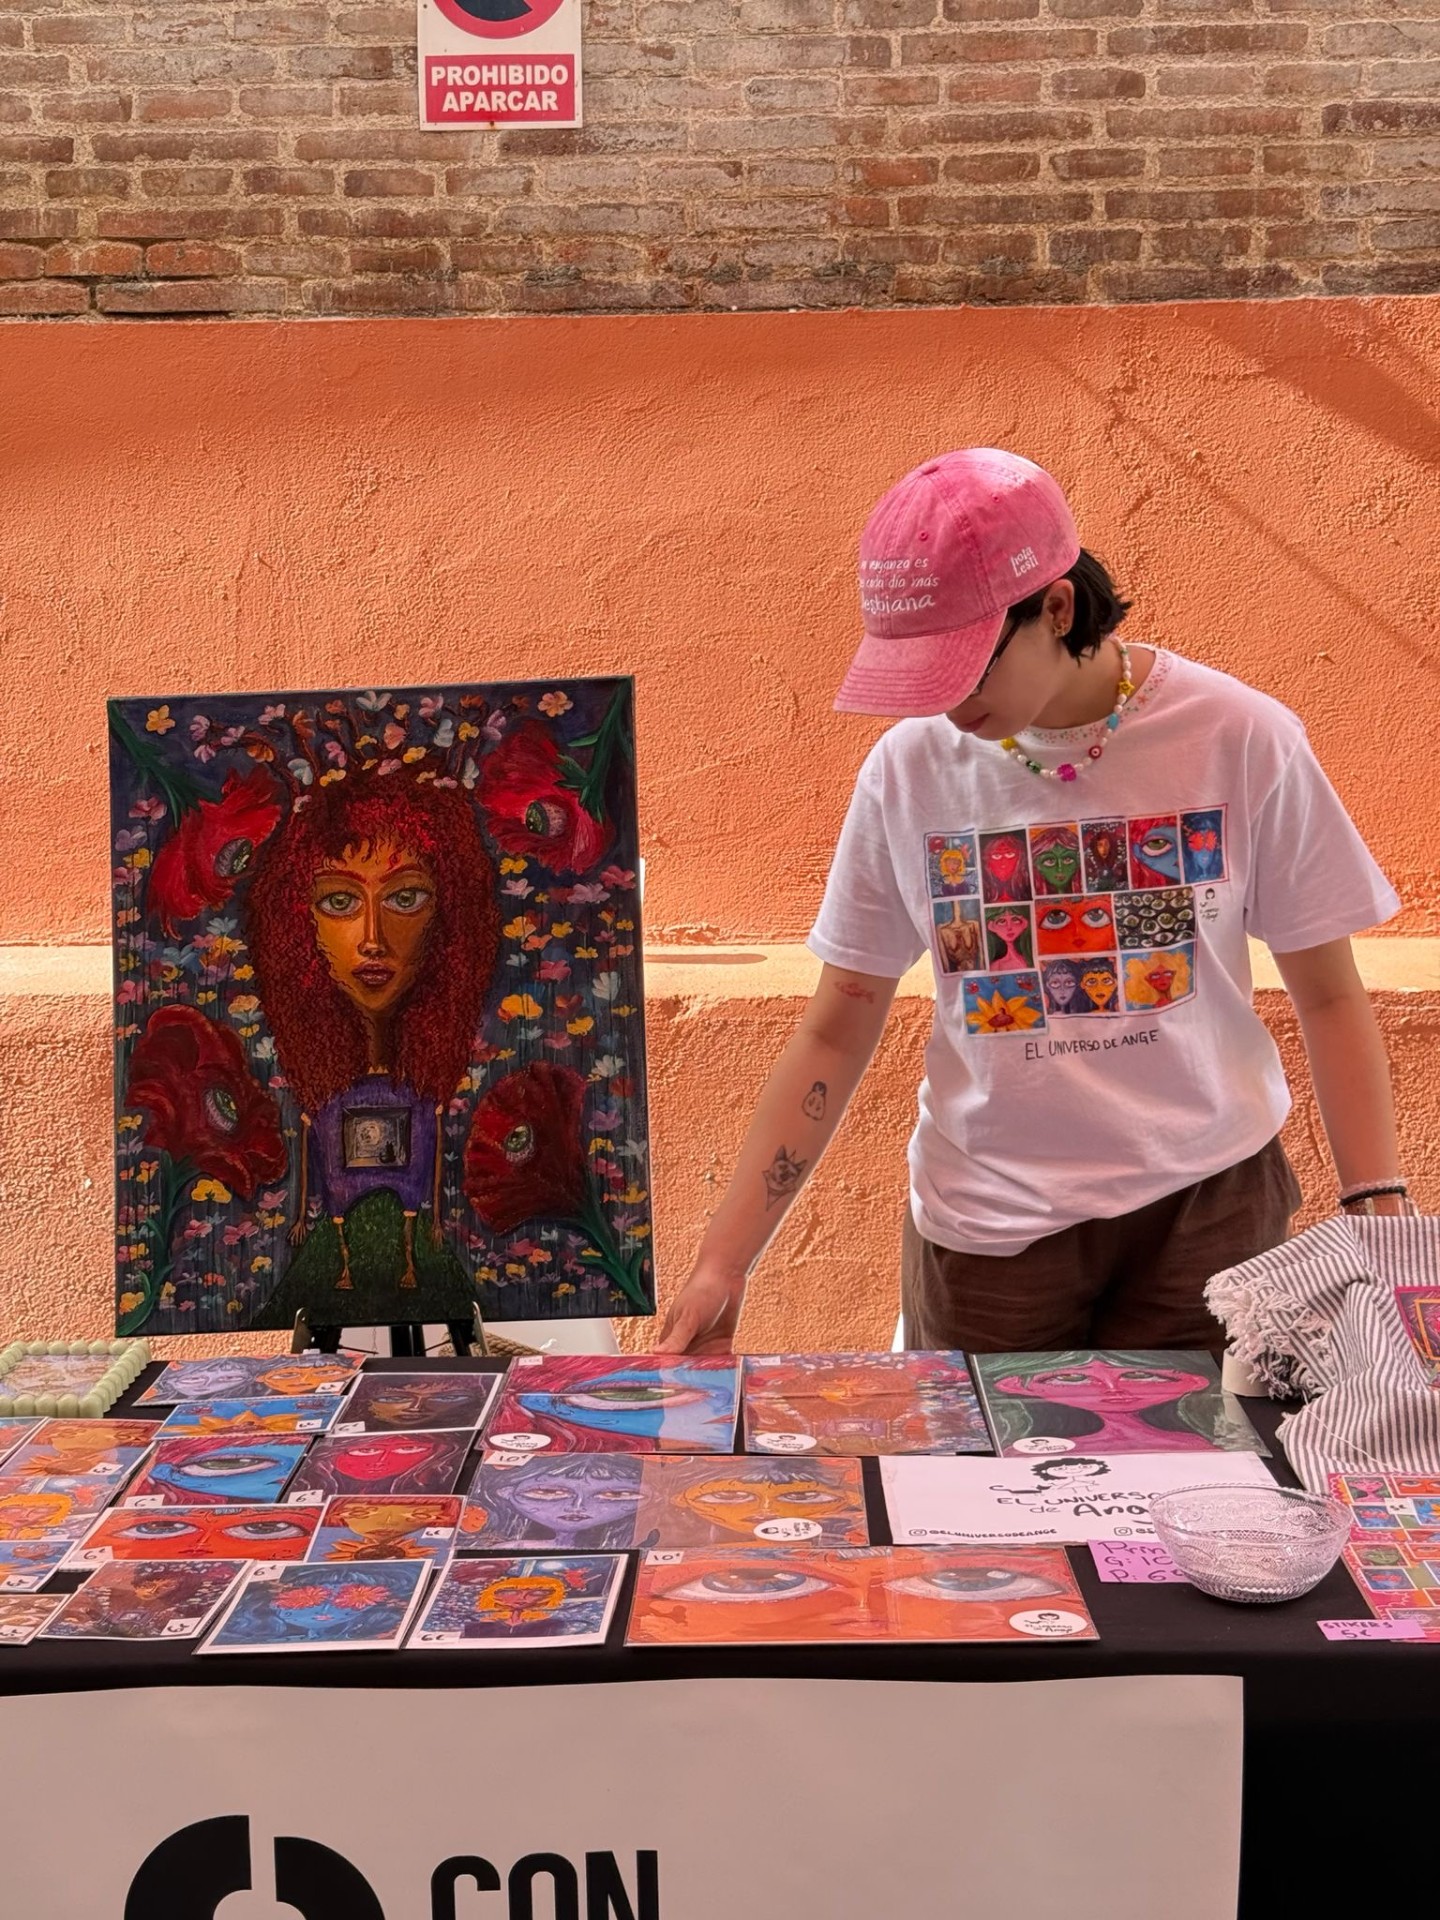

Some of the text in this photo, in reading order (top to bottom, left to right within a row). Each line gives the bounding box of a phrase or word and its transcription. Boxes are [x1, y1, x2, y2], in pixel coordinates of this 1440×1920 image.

[431, 65, 569, 86] PROHIBIDO
[442, 91, 559, 112] APARCAR
[1025, 1029, 1159, 1060] EL UNIVERSO DE ANGE
[996, 1497, 1033, 1505] EL
[1029, 1503, 1153, 1525] de Ang
[1097, 1541, 1167, 1555] Prin
